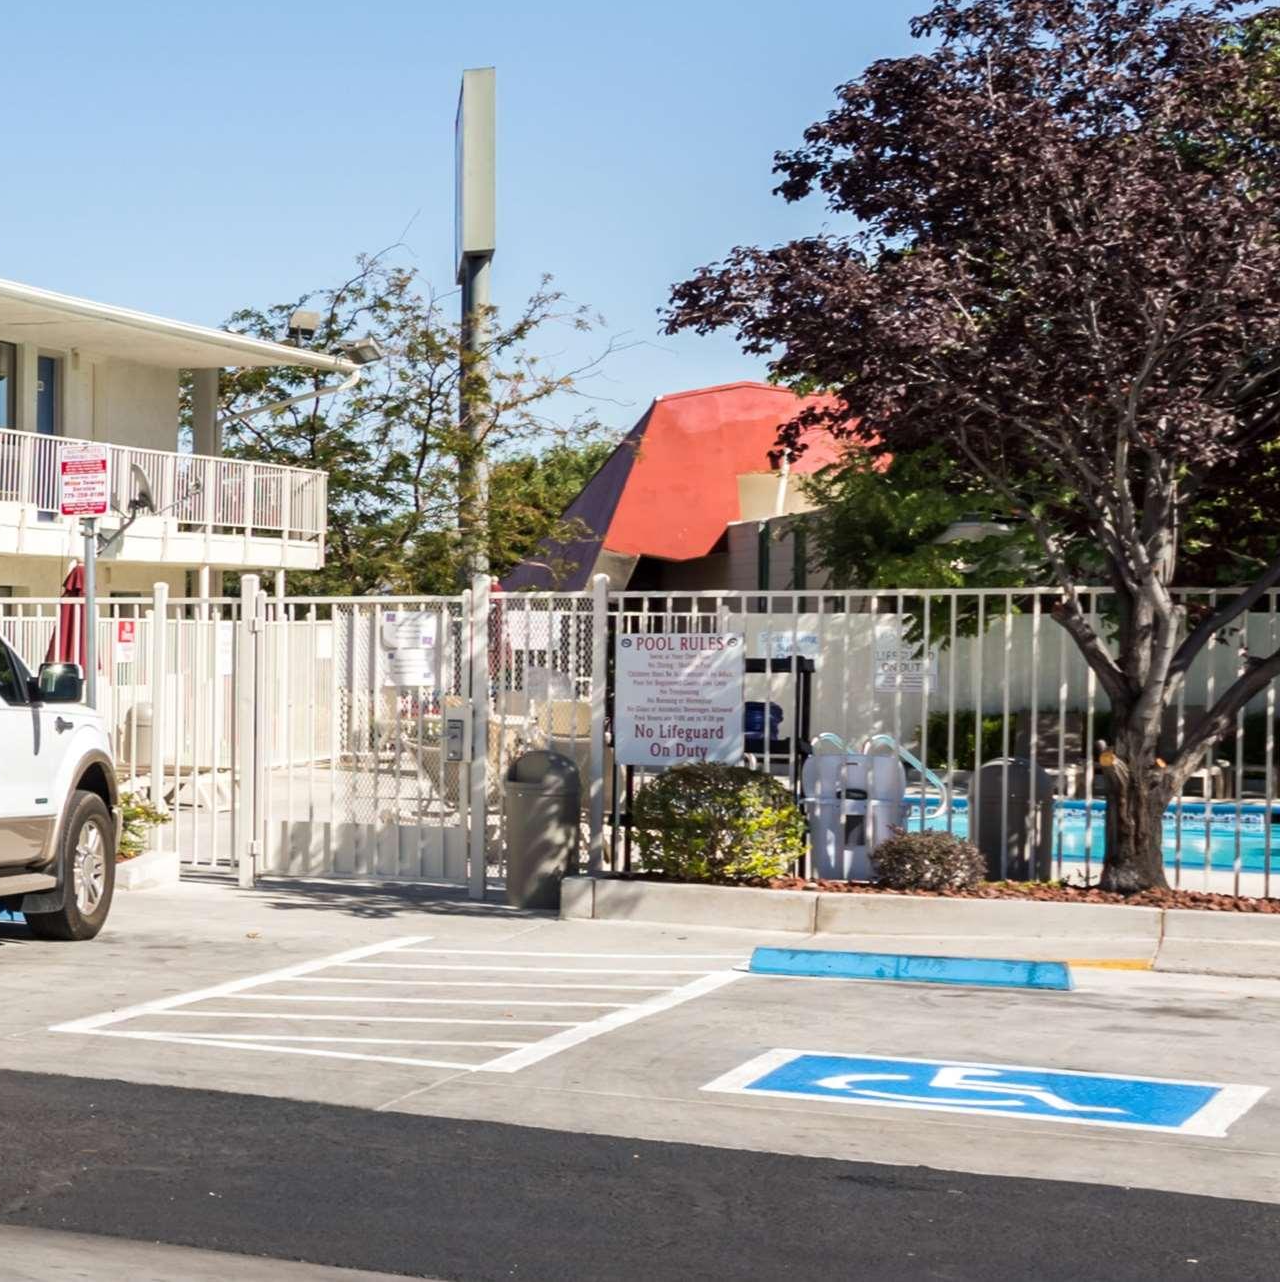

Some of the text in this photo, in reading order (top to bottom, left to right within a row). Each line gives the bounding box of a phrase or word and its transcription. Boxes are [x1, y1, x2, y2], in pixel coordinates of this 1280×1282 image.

[636, 637, 725, 650] POOL RULES
[635, 724, 724, 742] No Lifeguard
[650, 742, 708, 760] On Duty
